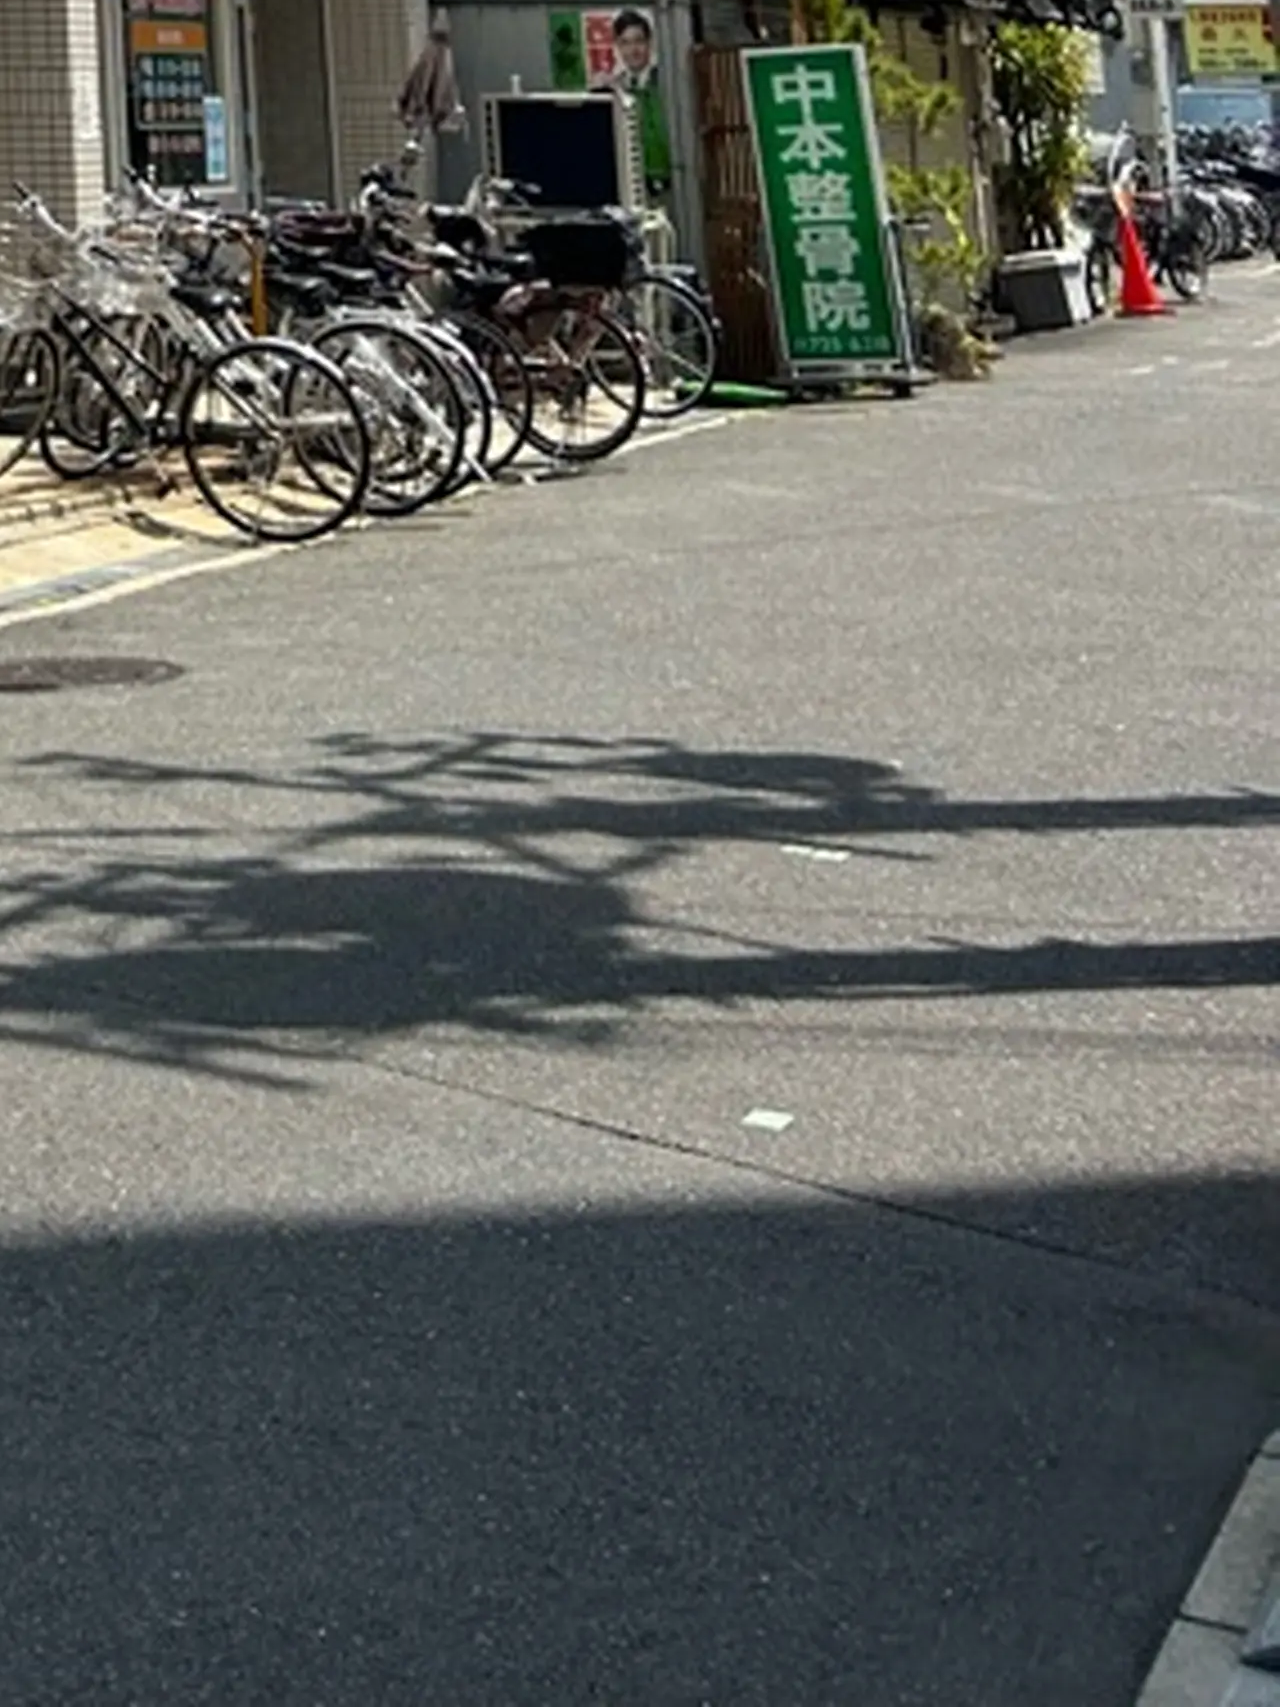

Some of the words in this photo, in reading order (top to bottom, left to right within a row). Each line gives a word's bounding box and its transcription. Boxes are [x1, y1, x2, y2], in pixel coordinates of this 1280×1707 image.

[771, 63, 871, 333] 中本整骨院
